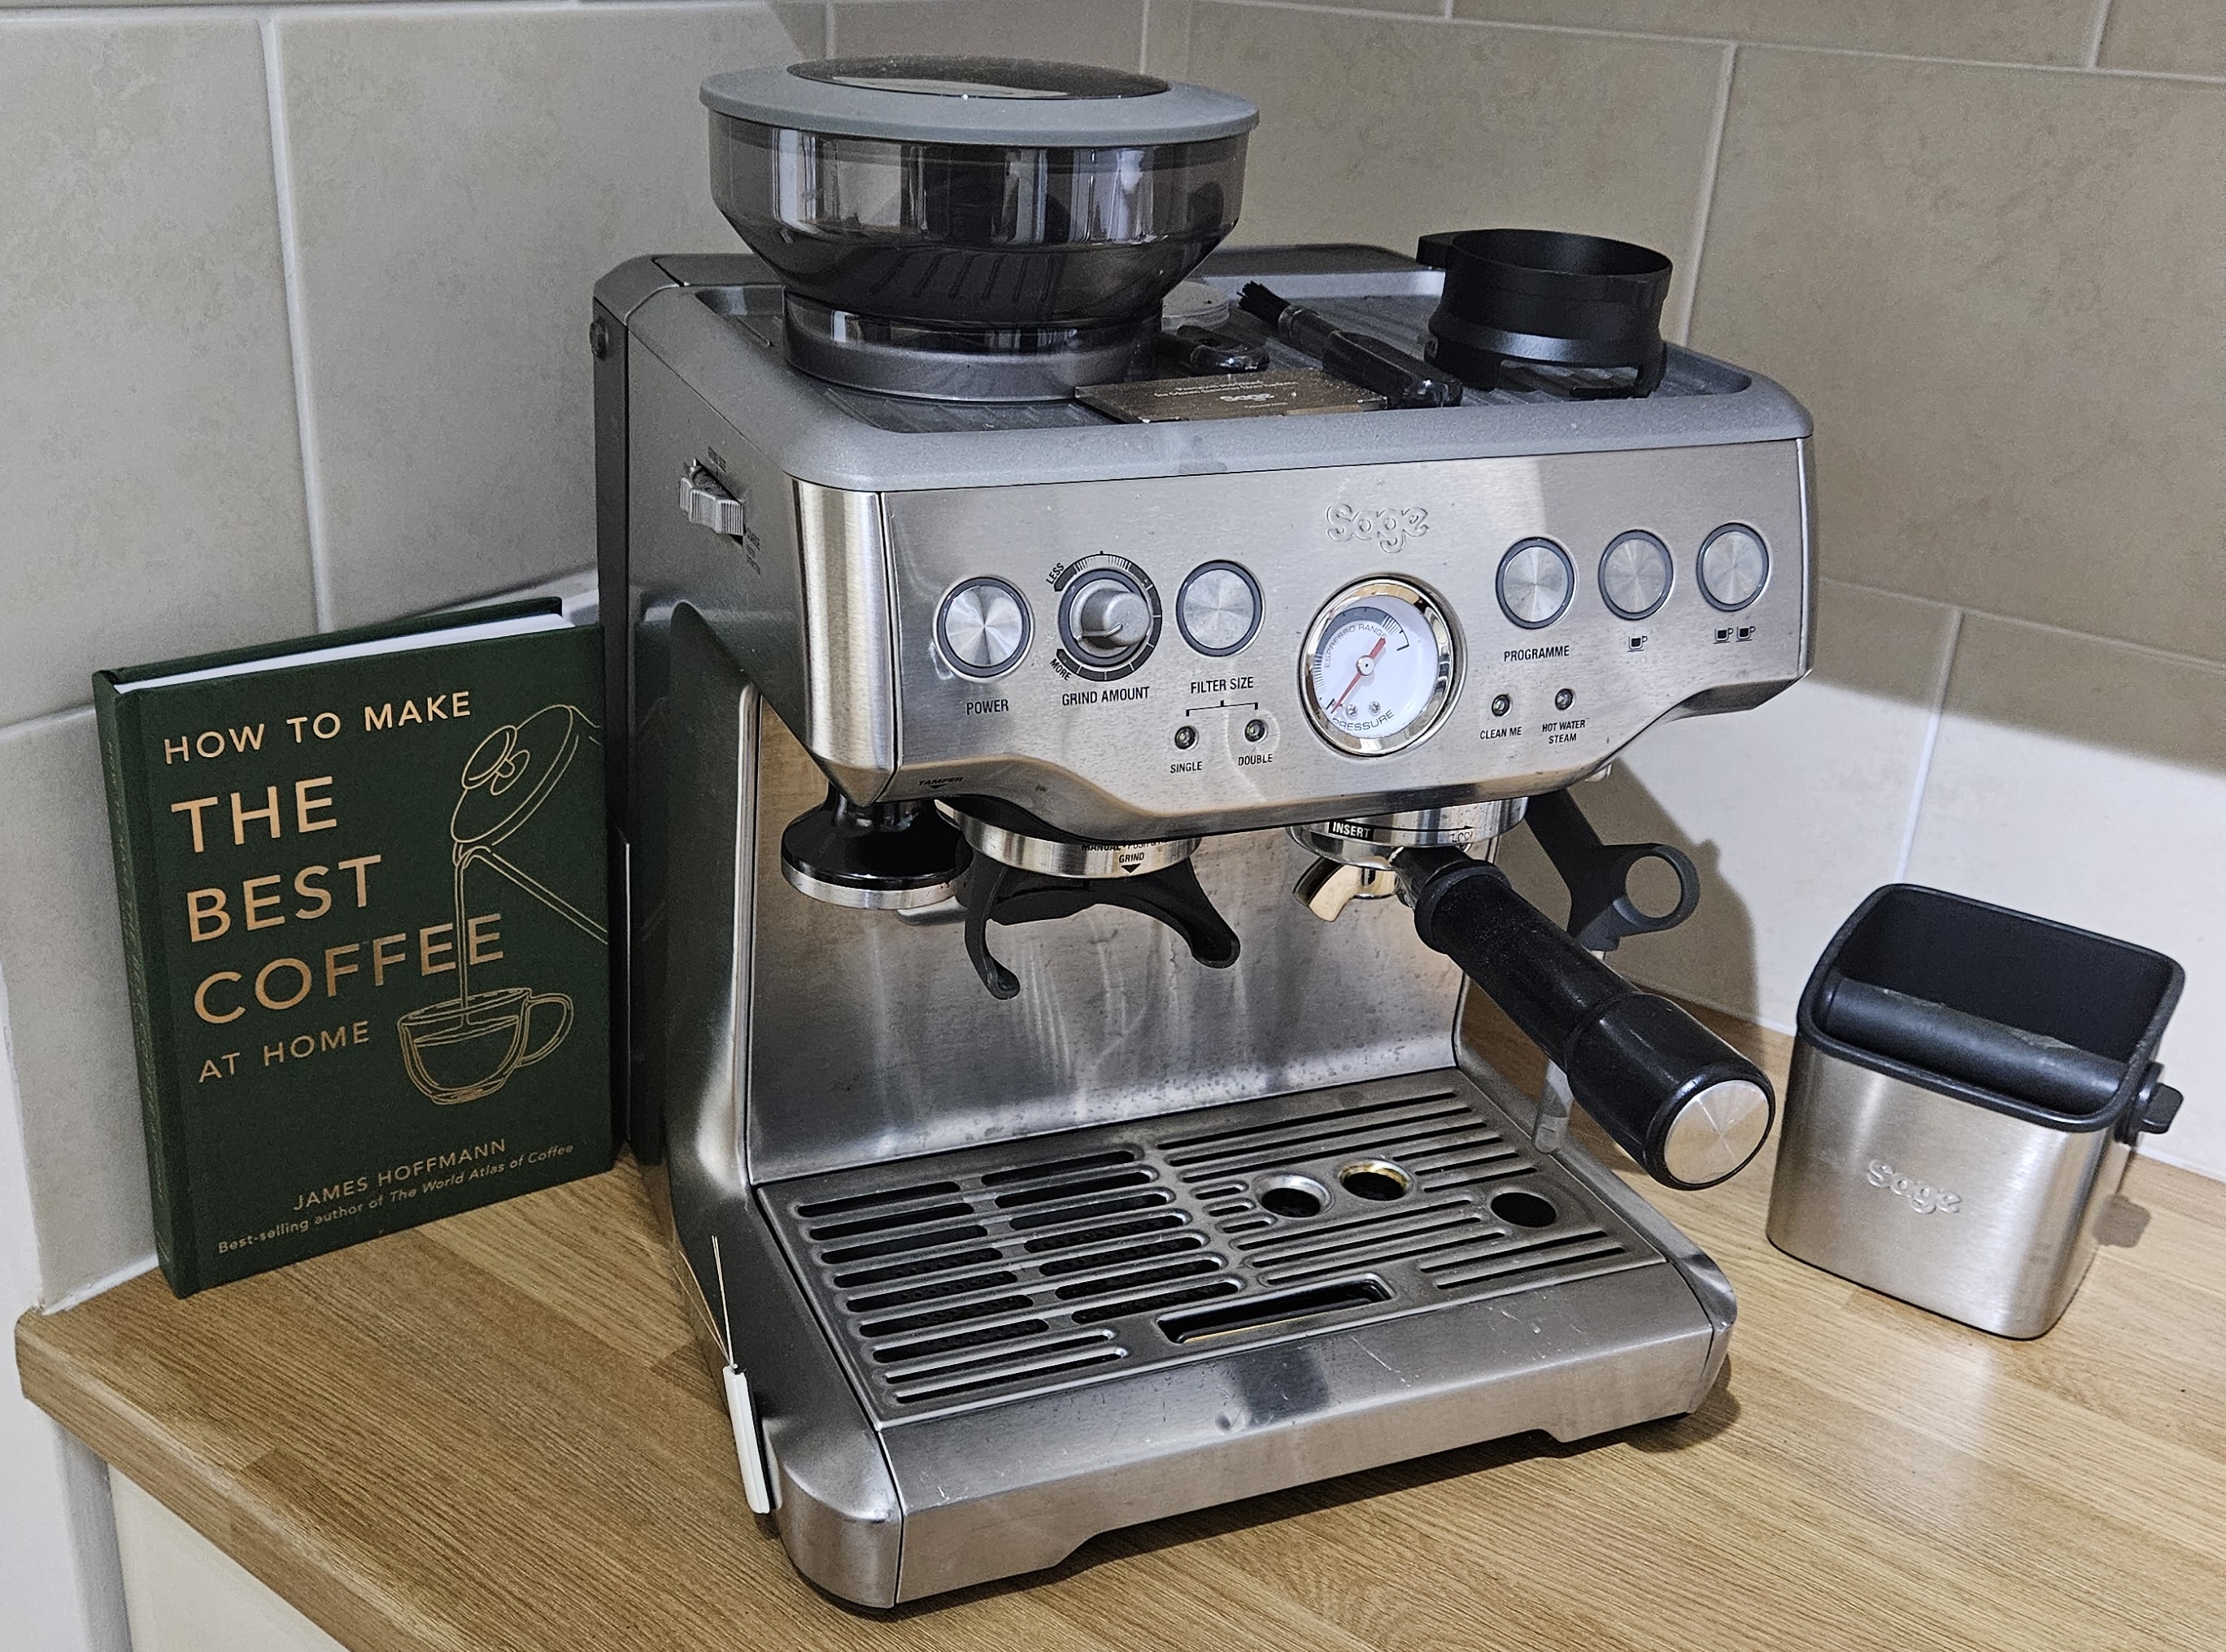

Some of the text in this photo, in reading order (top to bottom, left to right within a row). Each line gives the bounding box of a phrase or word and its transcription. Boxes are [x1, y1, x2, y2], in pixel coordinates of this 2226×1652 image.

[1326, 503, 1429, 554] Sage
[1045, 562, 1065, 585] LESS
[1324, 625, 1356, 669] ESPRESSO
[1504, 645, 1570, 662] PROGRAMME
[1049, 658, 1072, 681] MORE
[1062, 687, 1150, 706] GRIND AMOUNT
[1191, 676, 1254, 694] FILTER SIZE
[966, 699, 1008, 715] POWER
[163, 691, 472, 765] HOW TO MAKE
[1332, 708, 1395, 731] PRESSURE
[1542, 719, 1586, 733] HOT WATER
[1479, 726, 1522, 740] CLEAN ME
[1549, 733, 1577, 744] STEAM
[1170, 761, 1203, 774] SINGLE
[1238, 753, 1273, 765] DOUBLE
[918, 777, 964, 786] TAMPER
[171, 775, 338, 853] THE
[1332, 822, 1371, 839] INSERT
[1118, 852, 1145, 863] GRIND
[186, 855, 382, 943] BEST
[193, 913, 504, 1025] COFFEE
[198, 1021, 370, 1083] AT HOME
[293, 1139, 506, 1211] JAMES HOFFMANN
[1867, 1159, 1962, 1214] Sage
[218, 1144, 574, 1253] Best-selling author of The World Atlas of Coffee
